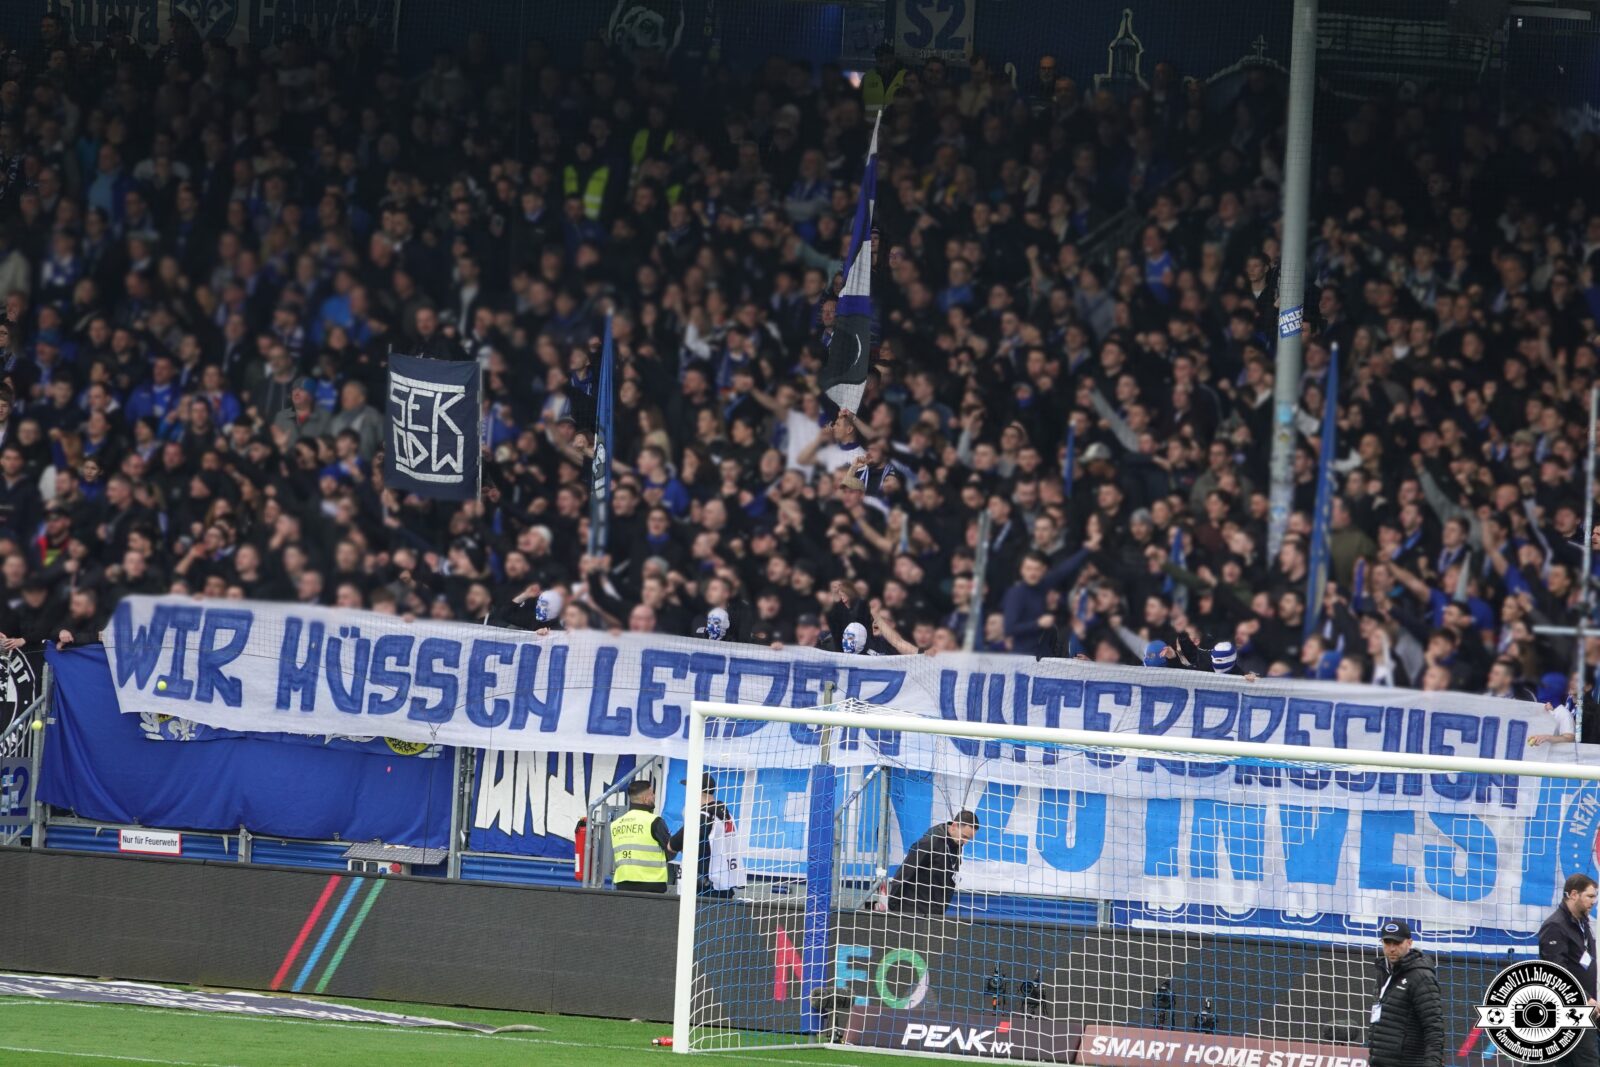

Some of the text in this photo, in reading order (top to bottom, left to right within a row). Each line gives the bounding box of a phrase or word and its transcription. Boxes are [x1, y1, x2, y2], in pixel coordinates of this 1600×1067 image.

[390, 381, 466, 435] SEK
[113, 601, 1529, 810] WIR MÜSSEN LEIDER UNTERBRECHEN
[122, 835, 178, 847] Nur für Feuerwehr
[612, 823, 644, 837] ORDNER
[726, 858, 738, 871] 16
[901, 1023, 995, 1053] PEAK
[1090, 1035, 1181, 1061] SMART
[1184, 1044, 1264, 1067] HOME
